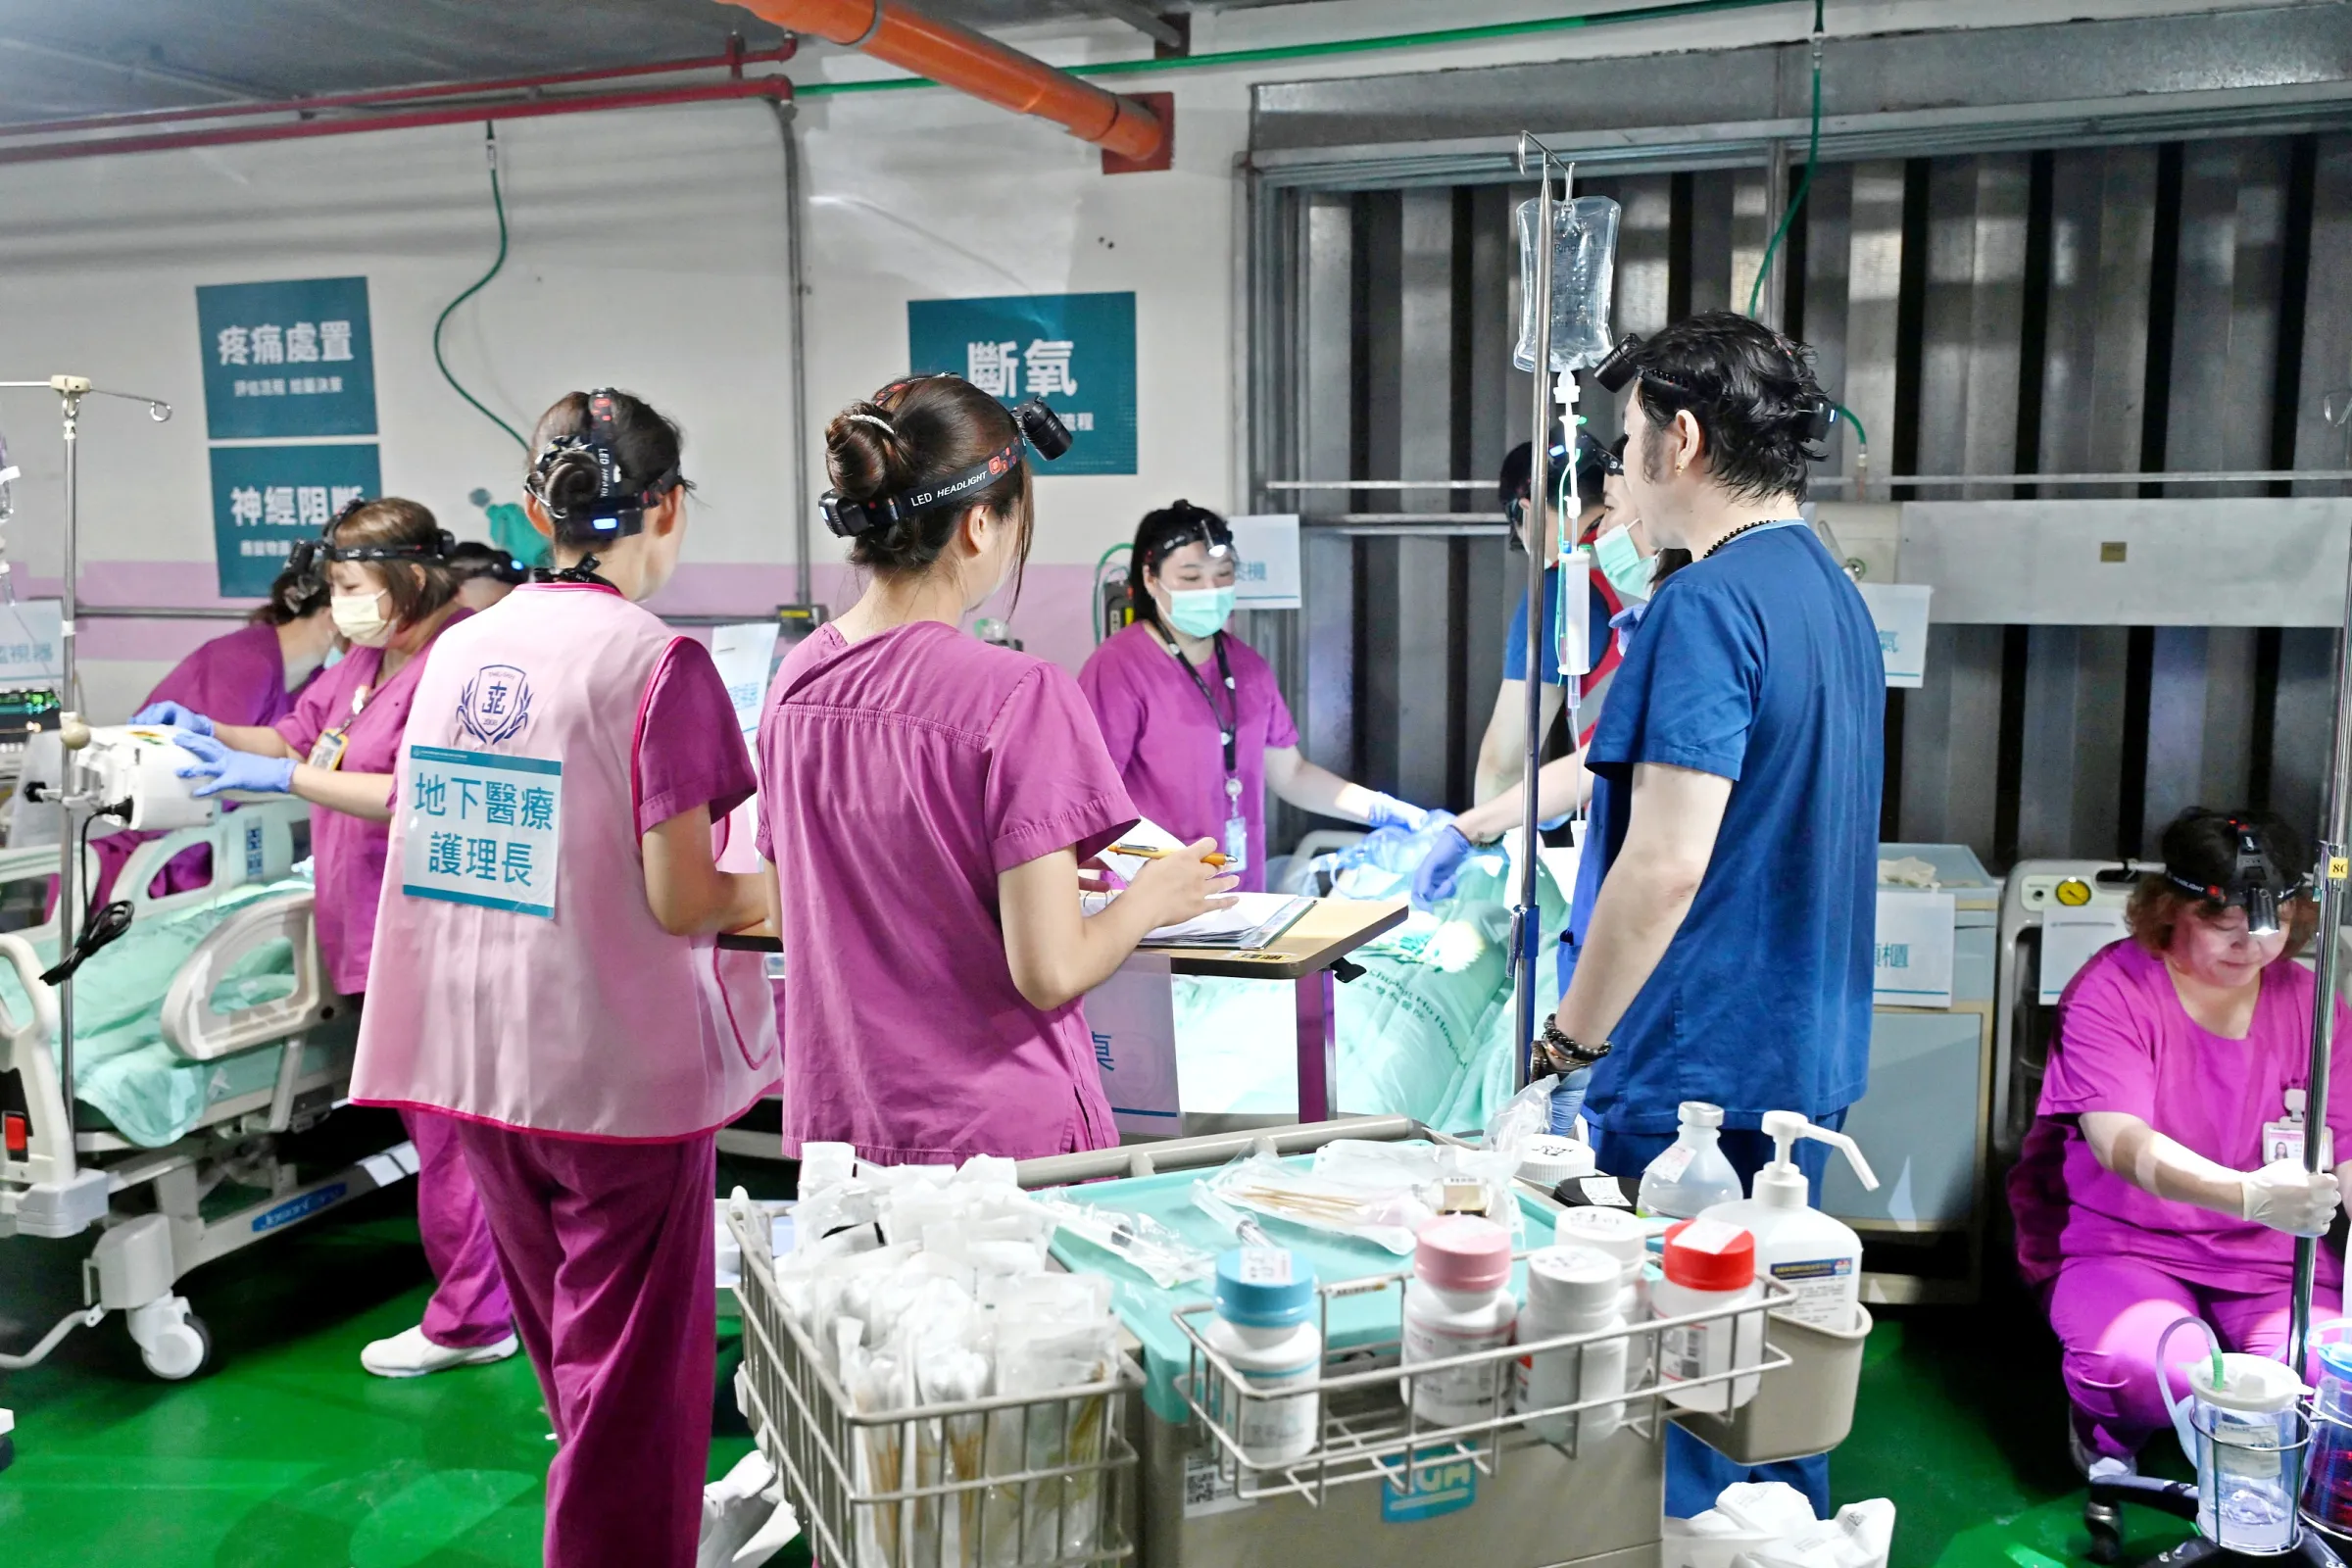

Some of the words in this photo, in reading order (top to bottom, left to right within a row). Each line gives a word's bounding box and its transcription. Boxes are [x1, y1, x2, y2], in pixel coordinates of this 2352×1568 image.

[218, 320, 354, 366] 疼痛處置
[968, 338, 1078, 398] 斷氧
[910, 492, 933, 508] LED
[937, 470, 987, 499] HEADLIGHT
[414, 772, 555, 831] 地下醫療
[428, 831, 533, 887] 護理長
